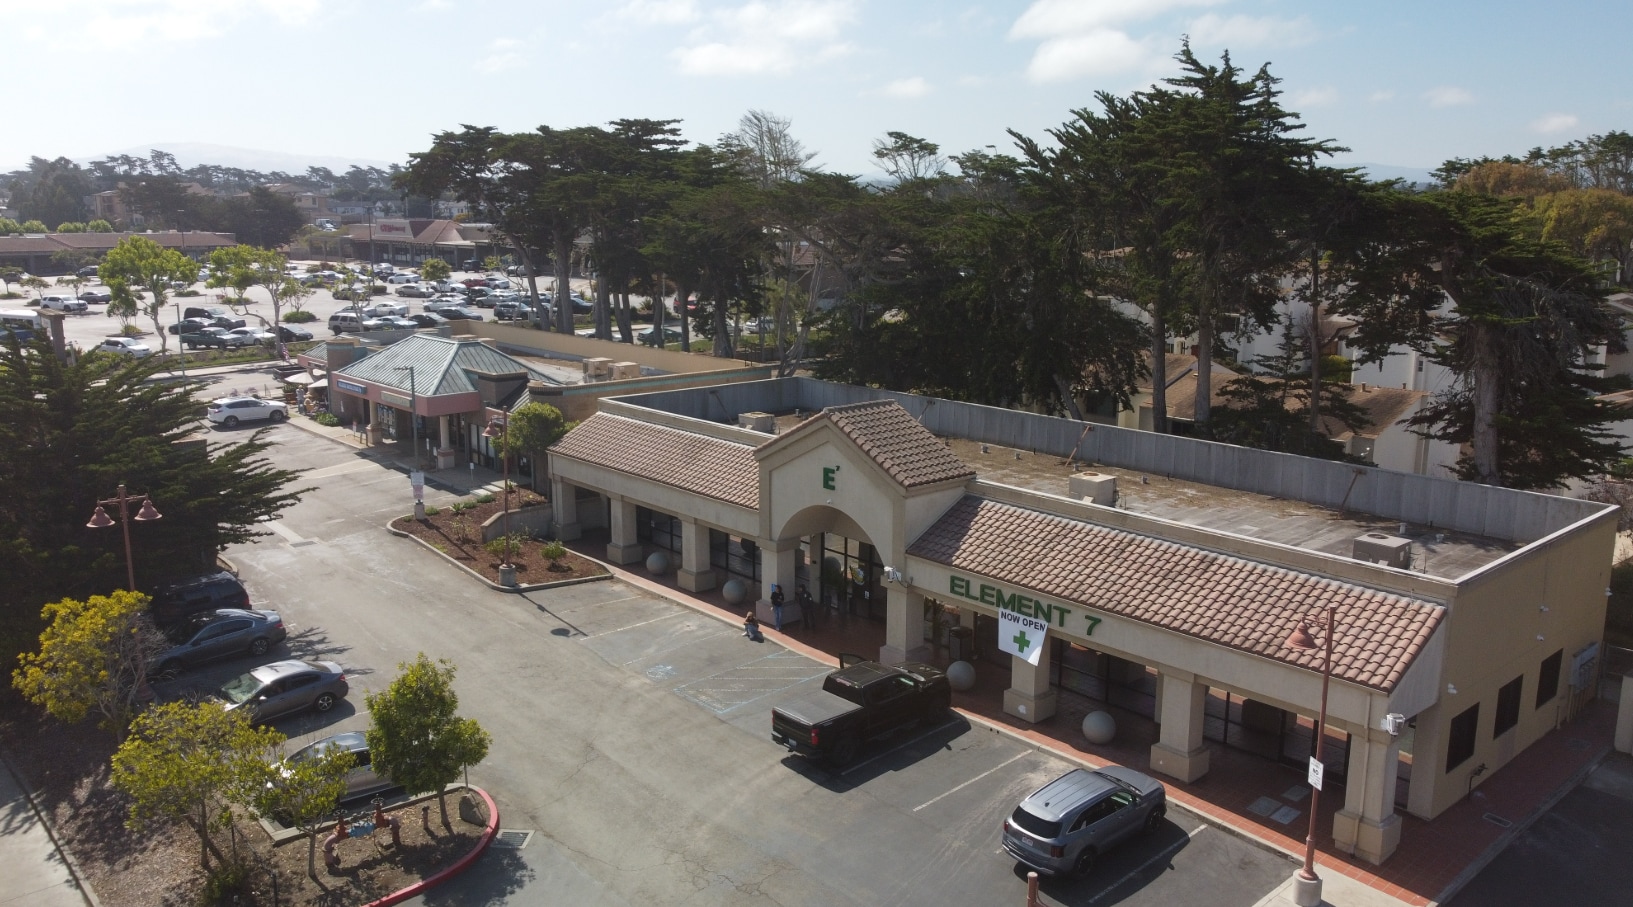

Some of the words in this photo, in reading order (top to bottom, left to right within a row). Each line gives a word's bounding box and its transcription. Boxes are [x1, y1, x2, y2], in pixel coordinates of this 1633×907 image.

[950, 575, 1071, 627] ELEMENT
[1085, 615, 1102, 636] 7
[1001, 612, 1021, 624] NOW
[1022, 618, 1046, 632] OPEN
